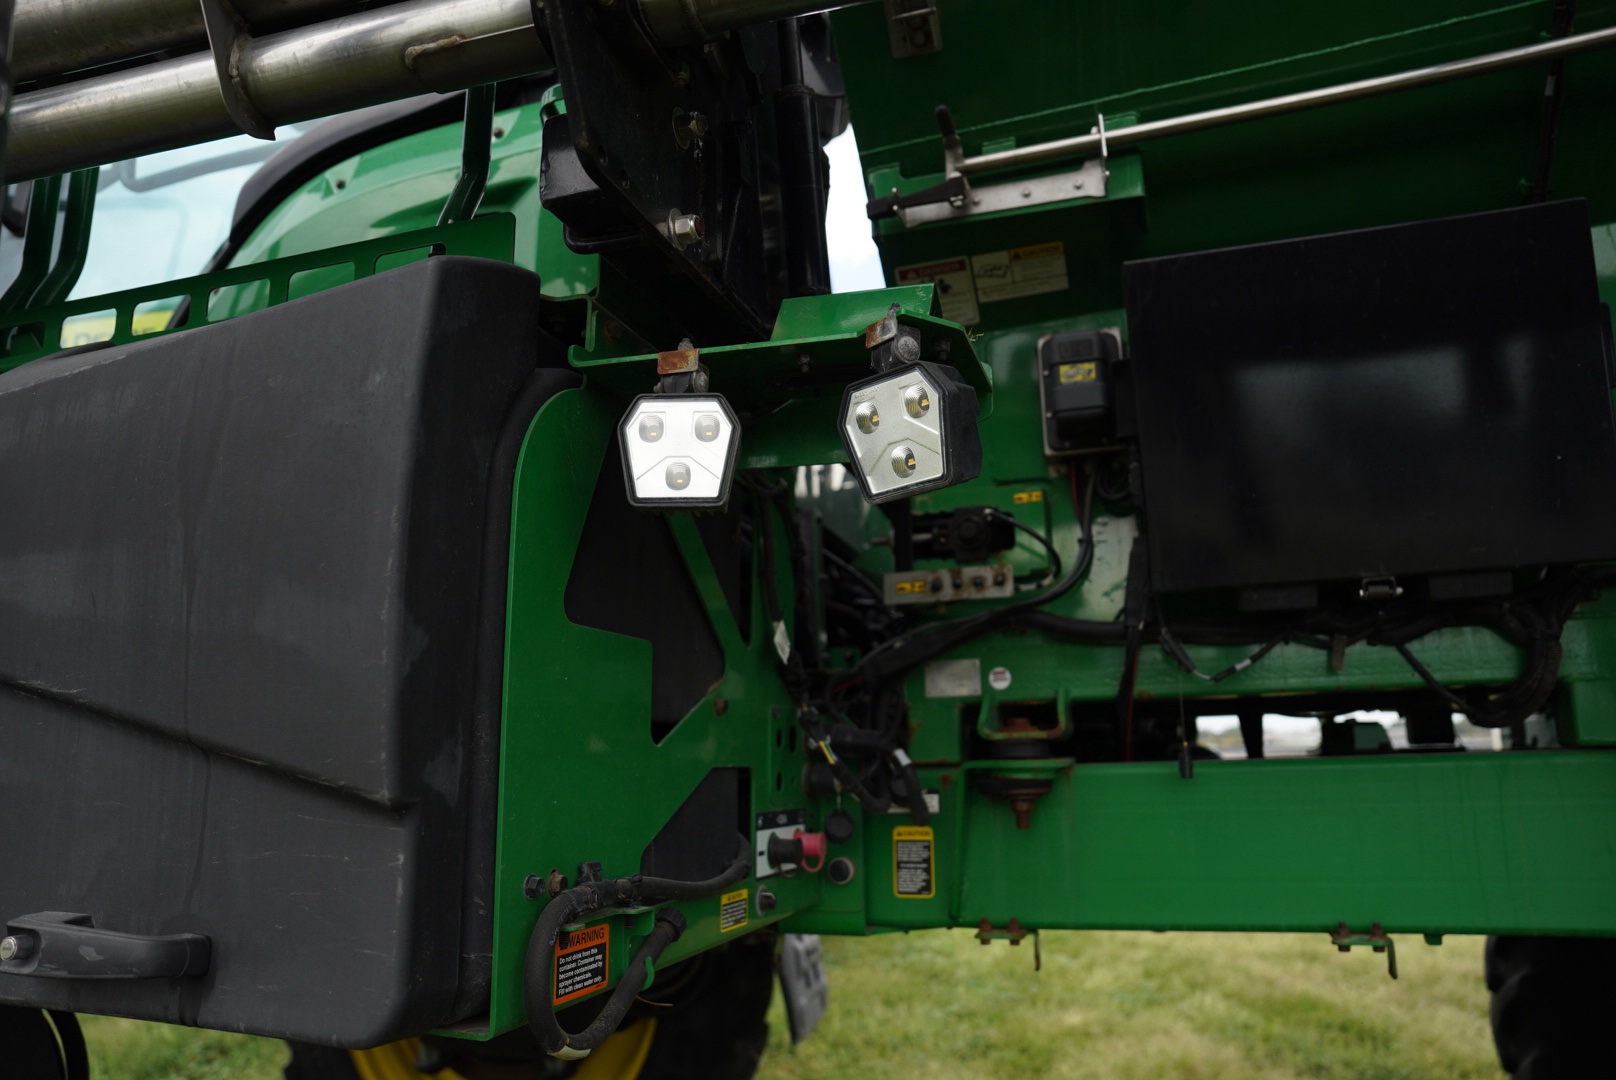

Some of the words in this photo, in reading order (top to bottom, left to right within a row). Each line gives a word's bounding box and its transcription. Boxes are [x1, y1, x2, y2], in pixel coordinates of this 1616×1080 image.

[569, 927, 604, 948] WARNING
[559, 962, 577, 972] container.
[578, 957, 594, 966] Container
[559, 970, 574, 980] become
[574, 962, 597, 975] contaminated
[559, 979, 572, 988] sprayer
[574, 972, 592, 982] chemicals.
[574, 982, 583, 990] clean
